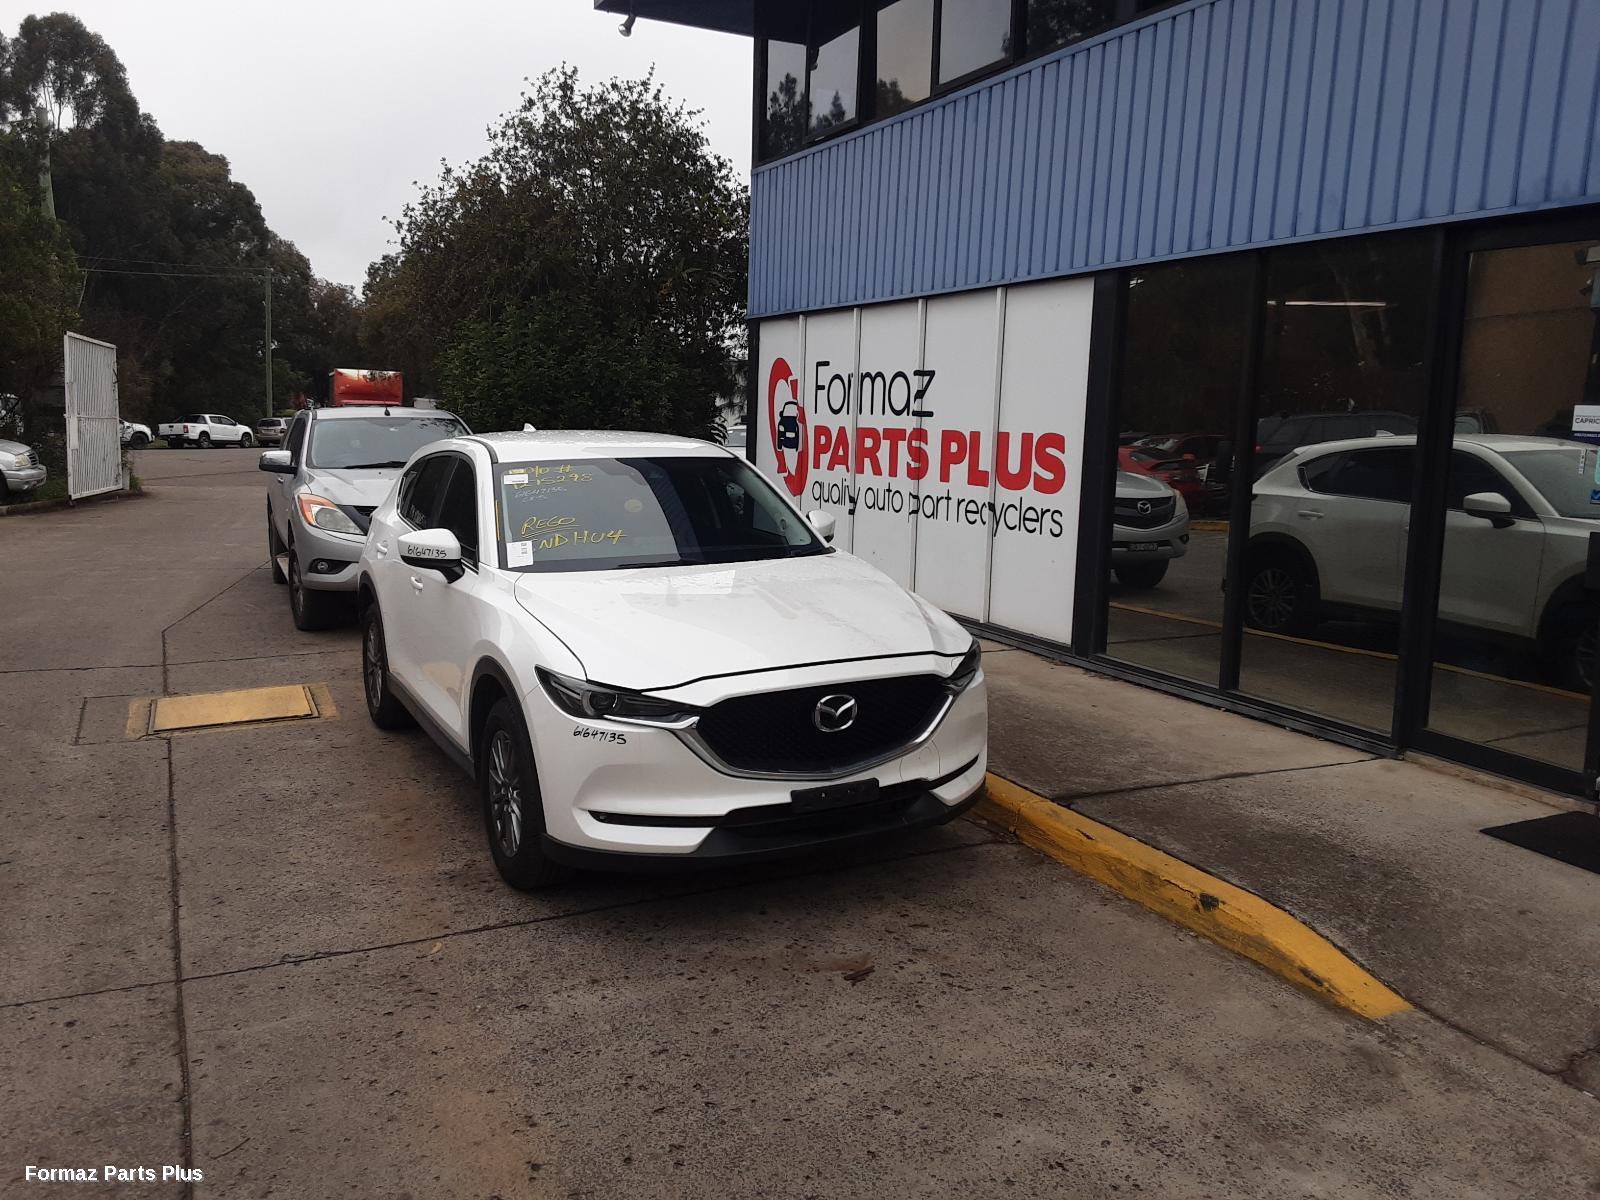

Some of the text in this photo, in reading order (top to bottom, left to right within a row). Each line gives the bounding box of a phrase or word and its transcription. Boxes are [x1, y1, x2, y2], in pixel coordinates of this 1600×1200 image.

[814, 361, 936, 418] Formaz
[812, 424, 1067, 495] PARTS PLUS
[812, 477, 1063, 538] qualiy auto part recyclers
[407, 544, 448, 559] 61647135
[573, 725, 627, 745] 61647135
